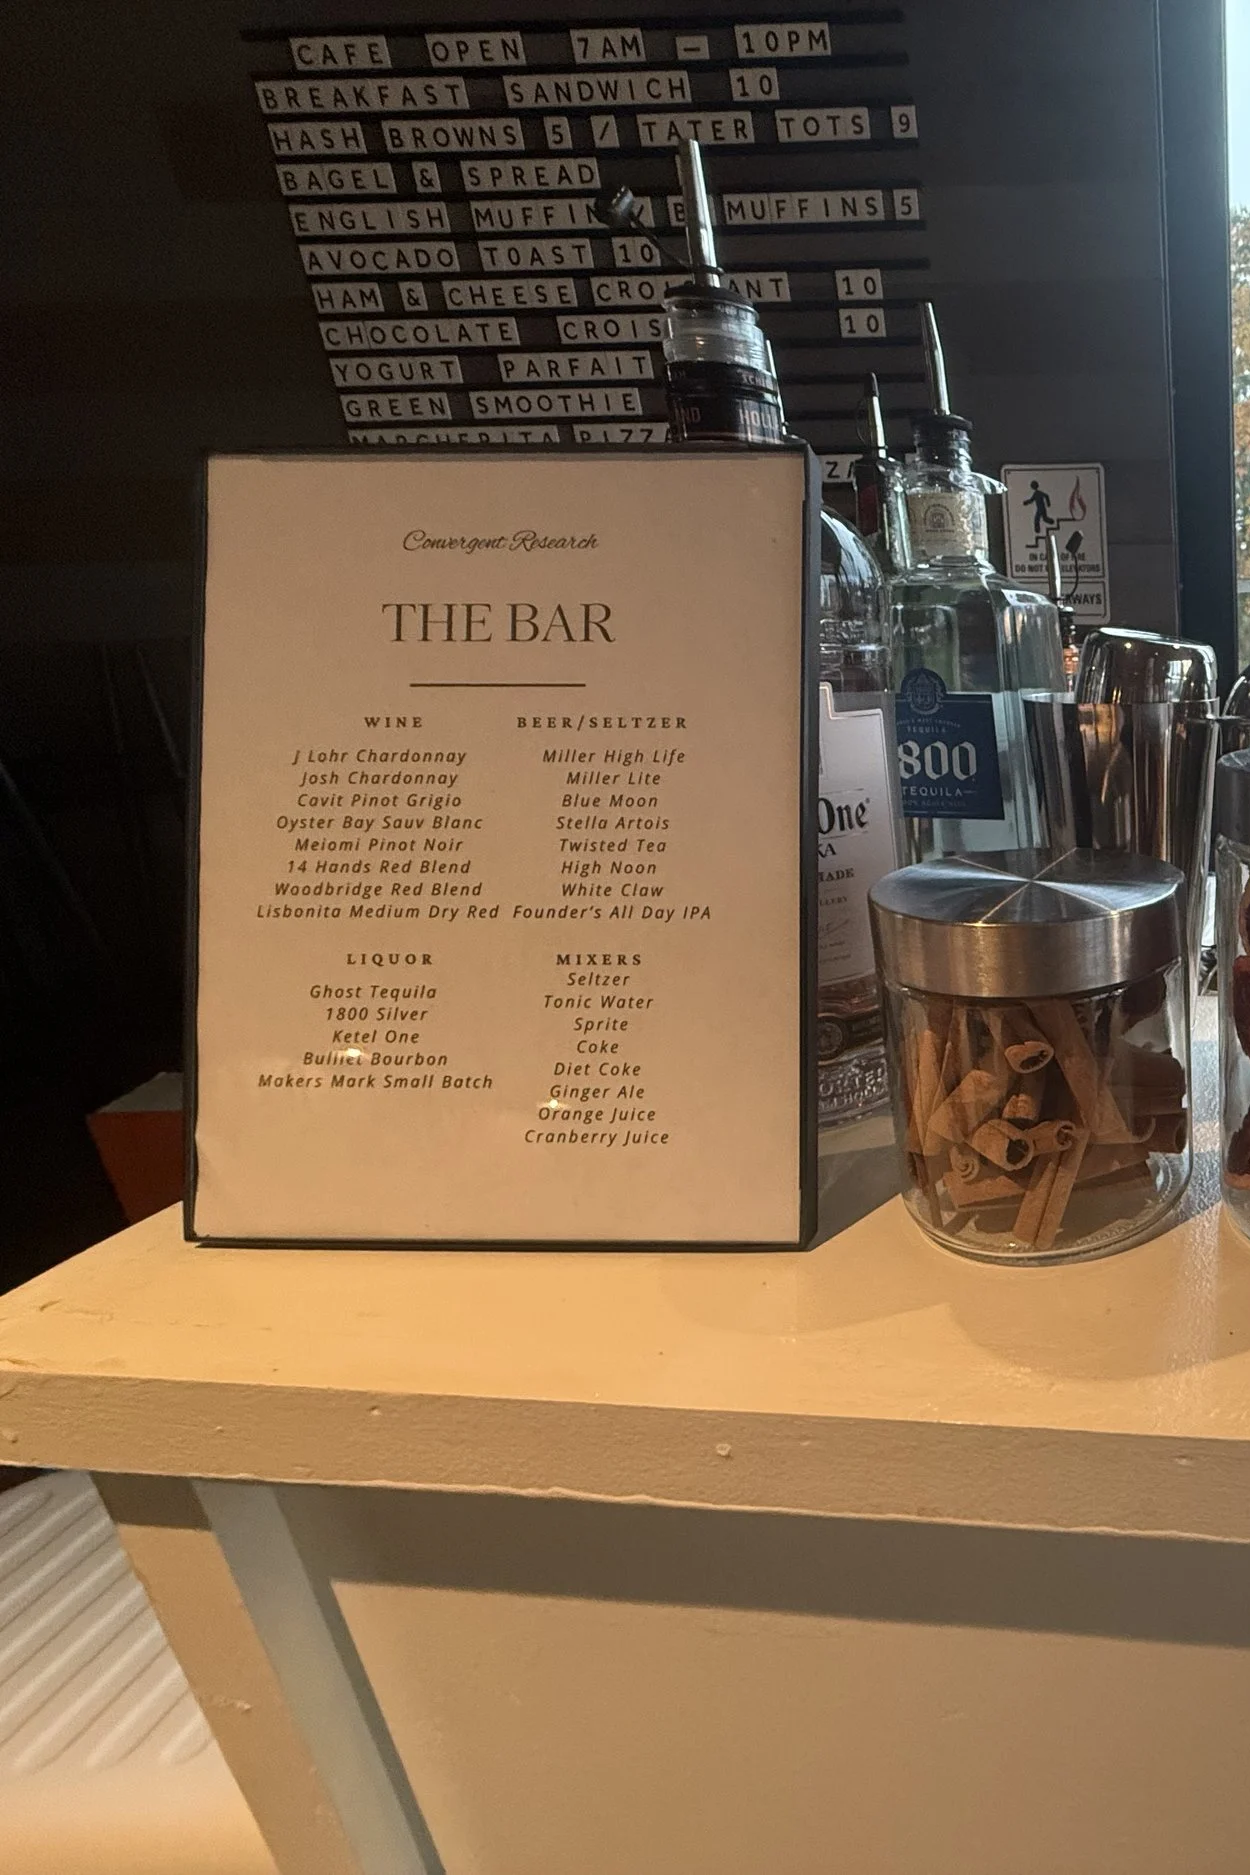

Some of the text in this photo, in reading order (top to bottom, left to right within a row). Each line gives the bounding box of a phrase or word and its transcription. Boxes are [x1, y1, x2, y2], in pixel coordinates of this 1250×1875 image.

[297, 42, 384, 65] CAFE
[432, 38, 520, 62] OPEN
[577, 35, 642, 59] 7AM
[743, 32, 828, 53] 10PM
[262, 76, 774, 109] BREAKFAST SANDWICH 10
[274, 113, 911, 150] HASH BROWNS 5 / TATER TOTS 9
[284, 164, 594, 191] BAGEL & SPREAD
[297, 208, 444, 232] ENGLISH
[728, 197, 878, 220] MUFFINS
[901, 197, 912, 215] 5
[308, 244, 654, 271] AVOCADO TOAST 10
[319, 276, 877, 309] HAM & CHEESE CROANT 10
[325, 314, 879, 346] CHOCOLATE CROIS 10
[335, 356, 646, 383] YOGURT PARFAIT
[347, 394, 636, 418] GREEN SMOOTHIE
[403, 530, 598, 554] Convergent Research
[382, 603, 615, 642] THE BAR
[364, 717, 422, 728] WINE
[517, 715, 686, 731] BEER/SELTZER
[292, 749, 466, 766] J Lohr Chardonnay
[543, 749, 685, 766] Miller High Life
[897, 739, 977, 781] 800
[299, 771, 458, 788] Josh Chardonnay
[567, 772, 660, 785] Miller Lite
[562, 793, 657, 807] Blue Moon
[902, 786, 963, 797] TEQUILA
[298, 794, 461, 810] Cavit Pinot Grigio
[277, 816, 482, 833] Oyster Bay Sauv Blanc
[556, 816, 669, 830] Stella Artois
[295, 838, 463, 851] Meiomi Pinot Noir
[560, 839, 666, 852] Twisted Tea
[289, 860, 471, 874] 14 Hands Red Blend
[561, 860, 656, 878] High Noon
[276, 882, 482, 899] Woodbridge Red Blend
[562, 883, 663, 897] White Claw
[257, 904, 499, 922] Lisbonita Medium Dry Red
[609, 905, 633, 919] All
[642, 906, 675, 923] Day
[683, 906, 710, 919] IPA
[347, 954, 432, 967] LIQUOR
[557, 954, 640, 965] MIXERS
[567, 972, 630, 986] Seltzer
[310, 985, 436, 1002] Ghost Tequila
[545, 995, 653, 1009] Tonic Water
[327, 1007, 428, 1021] 1800 Silver
[574, 1017, 628, 1035] Sprite
[333, 1030, 419, 1044] Ketel One
[577, 1040, 618, 1054] Coke
[371, 1052, 447, 1066] Bourbon
[554, 1062, 640, 1076] Diet Coke
[258, 1074, 492, 1089] Makers Mark Small Batch
[550, 1085, 644, 1102] Ginger Ale
[539, 1108, 655, 1124] Orange Juice
[525, 1129, 668, 1147] Cranberry Juice
